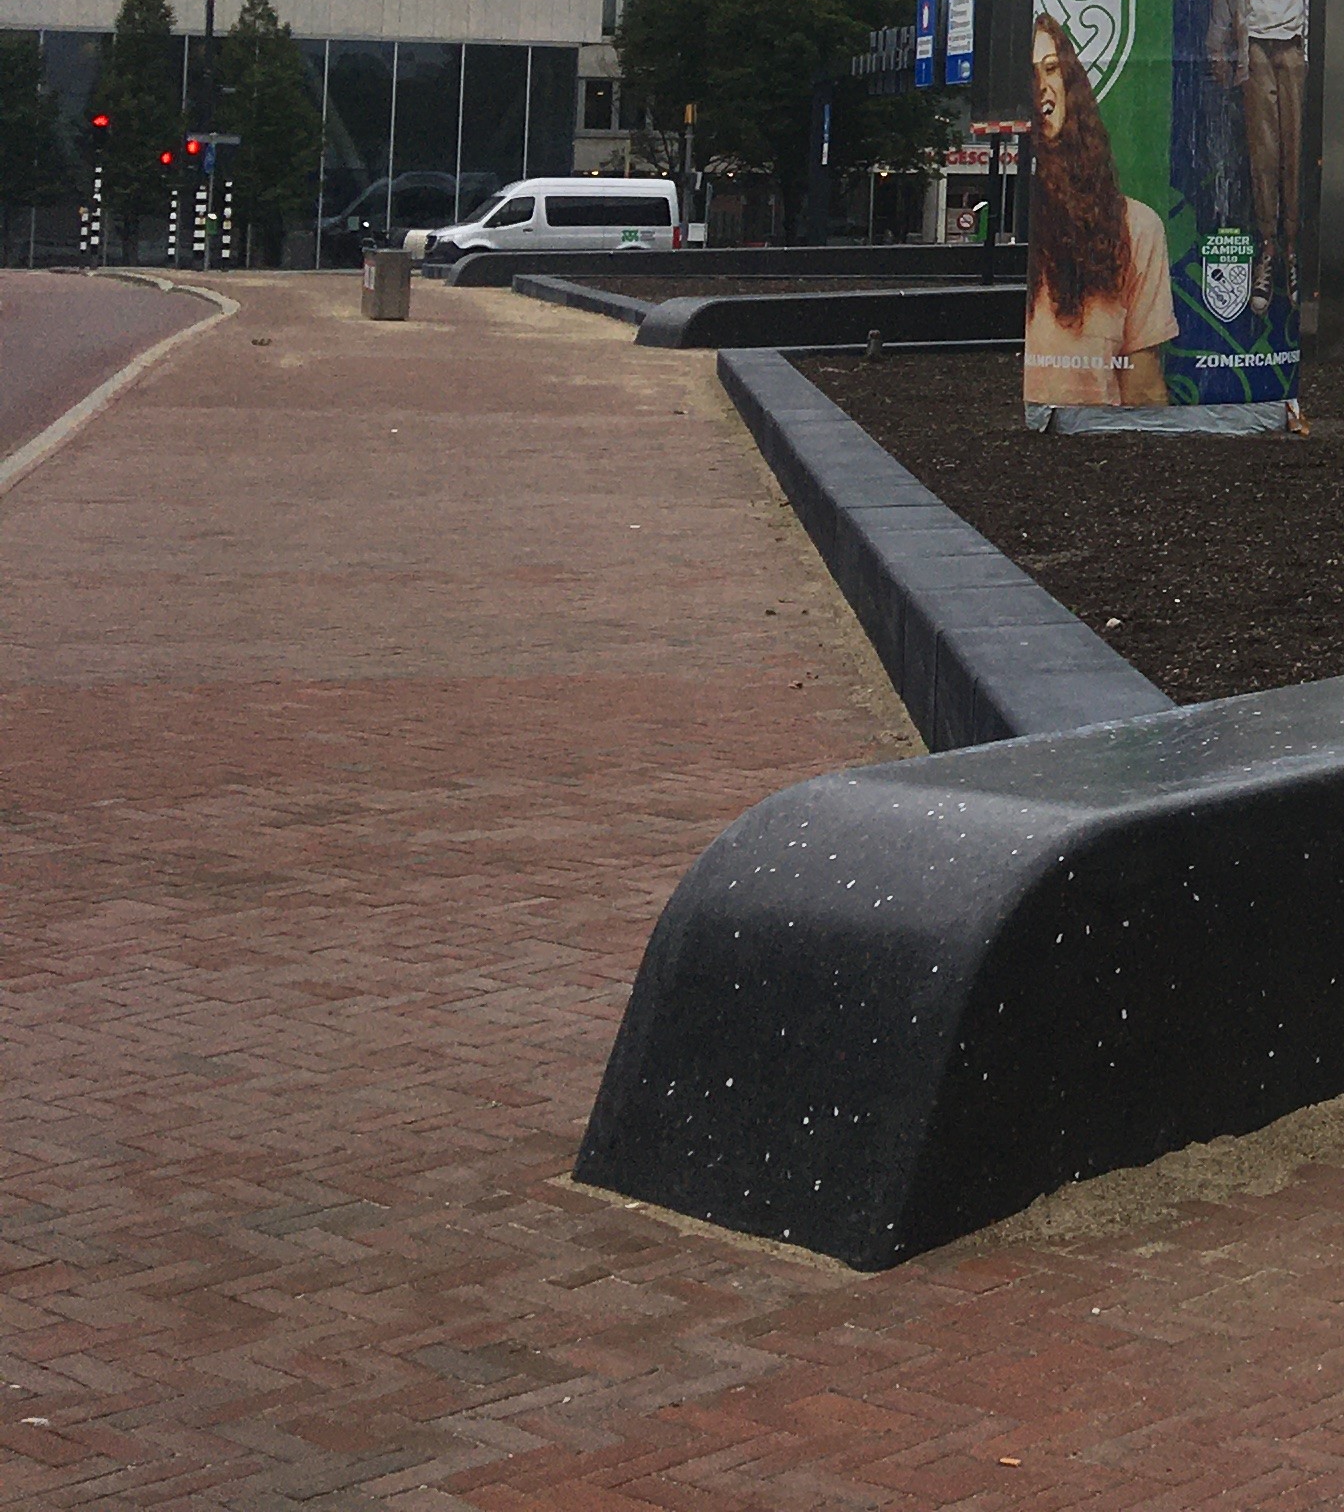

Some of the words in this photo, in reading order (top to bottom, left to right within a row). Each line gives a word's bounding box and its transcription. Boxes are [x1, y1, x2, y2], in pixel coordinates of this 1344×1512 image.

[1206, 235, 1250, 246] ZOMER
[1201, 245, 1254, 255] CAMPUS
[1219, 255, 1238, 263] 010
